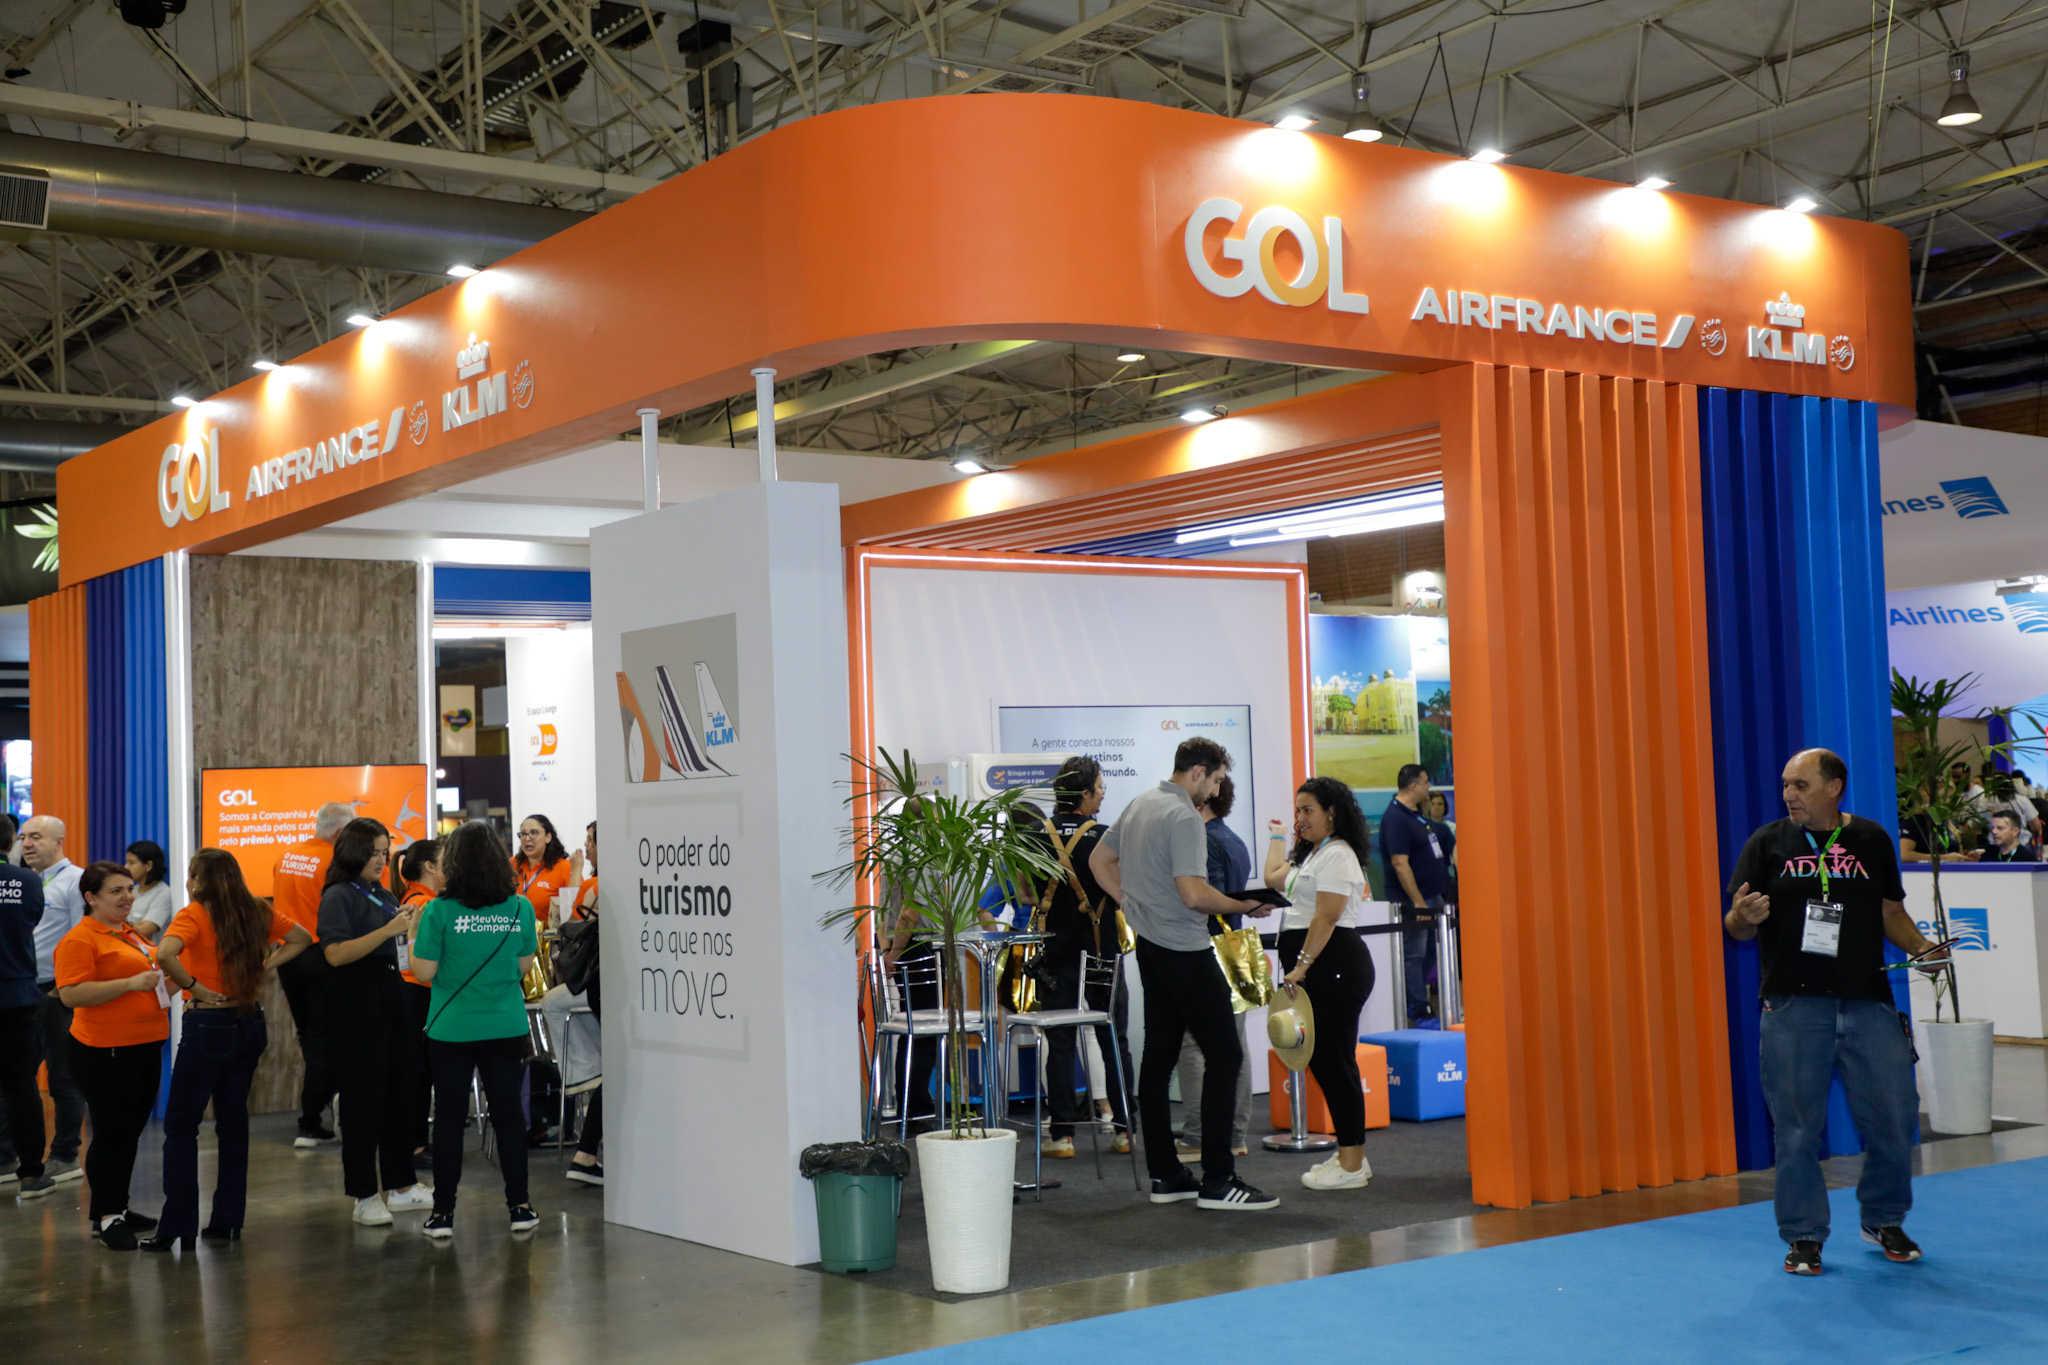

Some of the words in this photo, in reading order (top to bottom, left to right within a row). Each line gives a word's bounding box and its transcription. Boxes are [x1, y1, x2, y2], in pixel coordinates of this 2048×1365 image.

[1185, 197, 1369, 314] GOL
[1411, 287, 1658, 346] AIRFRANCE
[1748, 326, 1827, 365] KLM
[442, 370, 507, 432] KLM
[245, 420, 379, 501] AIRFRANCE
[158, 427, 230, 528] GOL
[1890, 606, 2005, 626] Airlines
[1161, 720, 1180, 730] GOL
[706, 728, 733, 747] KLM
[1032, 739, 1039, 748] A
[1041, 738, 1066, 750] gente
[1068, 738, 1103, 747] conecta
[1104, 738, 1135, 747] nossos
[1103, 767, 1138, 777] mundo.
[219, 789, 258, 806] GOL
[219, 812, 250, 822] Somos
[259, 810, 307, 821] Companhia
[219, 824, 240, 834] mais
[242, 823, 272, 832] amada
[273, 823, 297, 833] pelos
[219, 837, 238, 848] pelo
[240, 835, 275, 847] prêmio
[276, 834, 297, 845] Veja
[290, 854, 310, 862] poder
[310, 856, 321, 864] do
[639, 837, 651, 867] O
[656, 836, 703, 874] poder
[709, 835, 730, 866] do
[282, 860, 317, 872] TURISMO
[9, 879, 22, 887] do
[640, 873, 732, 917] turismo
[470, 923, 521, 933] Compensa
[641, 921, 649, 952] é
[654, 931, 664, 953] o
[668, 931, 698, 961] que
[703, 932, 733, 956] nos
[641, 967, 734, 1020] move.
[1437, 1071, 1462, 1082] KLM
